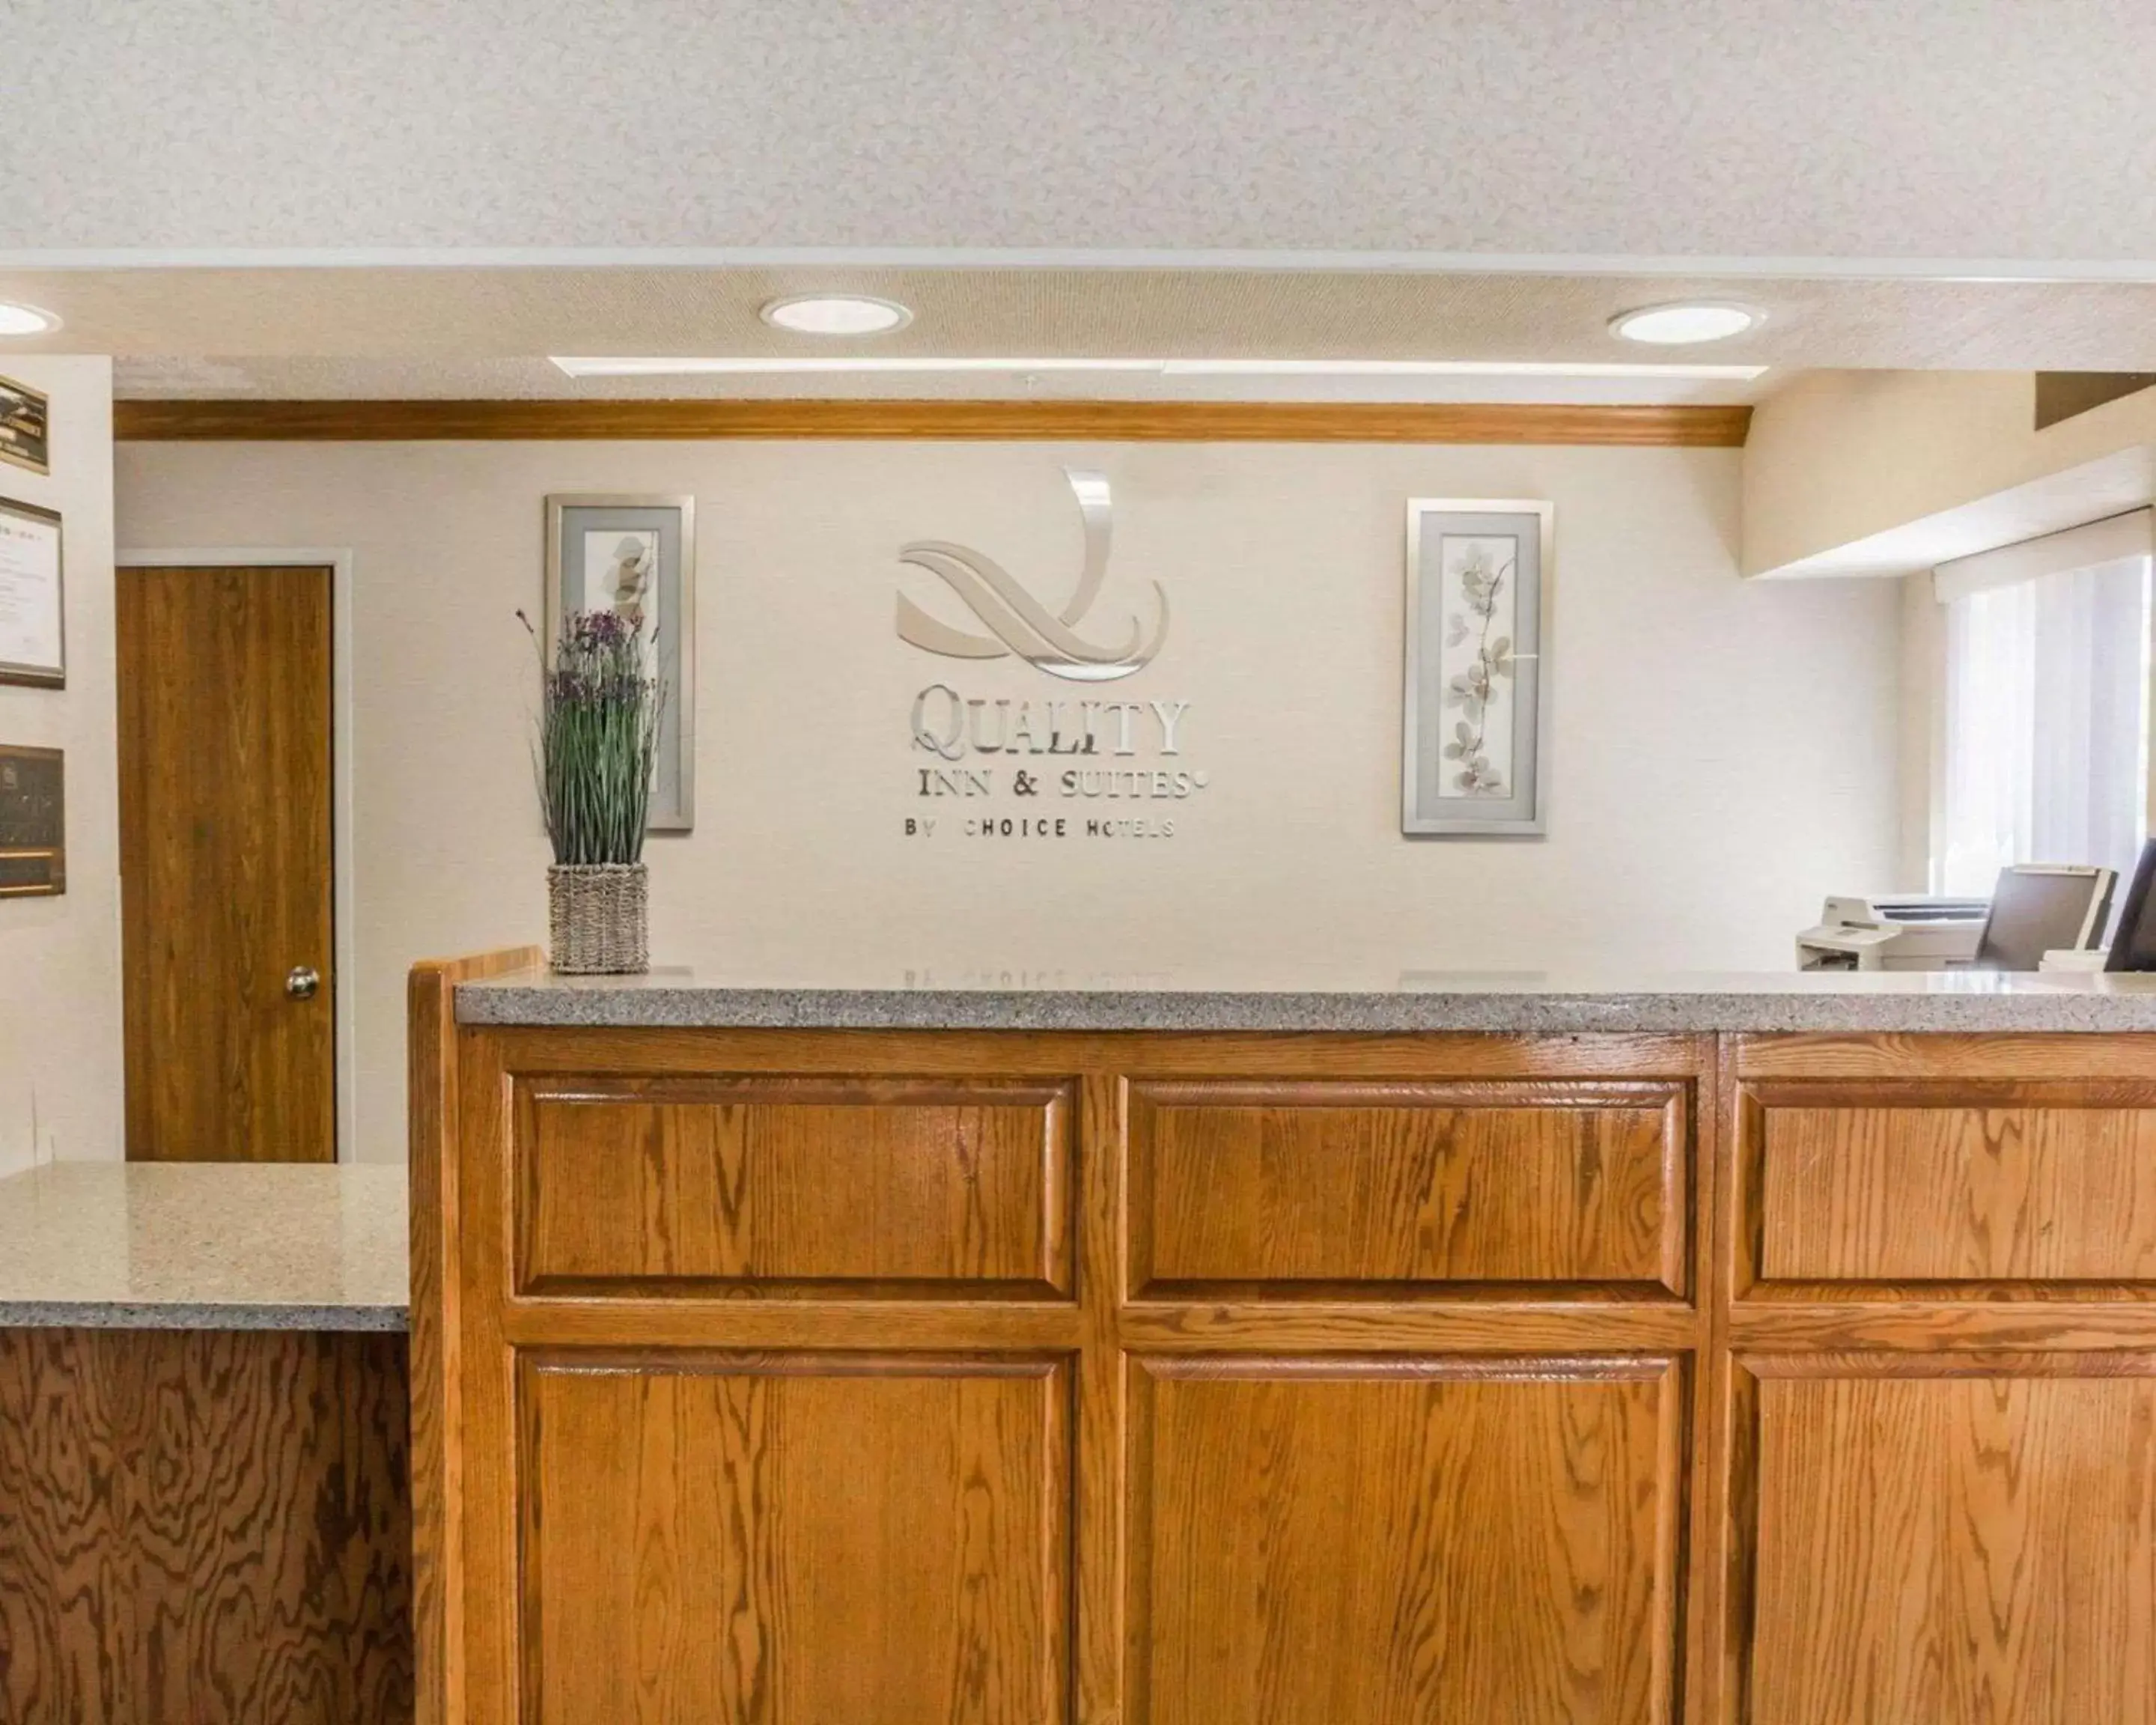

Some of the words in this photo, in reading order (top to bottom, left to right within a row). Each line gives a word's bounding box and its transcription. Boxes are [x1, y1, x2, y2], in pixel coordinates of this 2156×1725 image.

[910, 684, 1192, 761] QUALITY
[917, 768, 993, 797] INN
[1013, 770, 1038, 797] &
[904, 818, 936, 837] BY
[965, 818, 1066, 838] CHOICE
[1087, 818, 1175, 839] HOTELS
